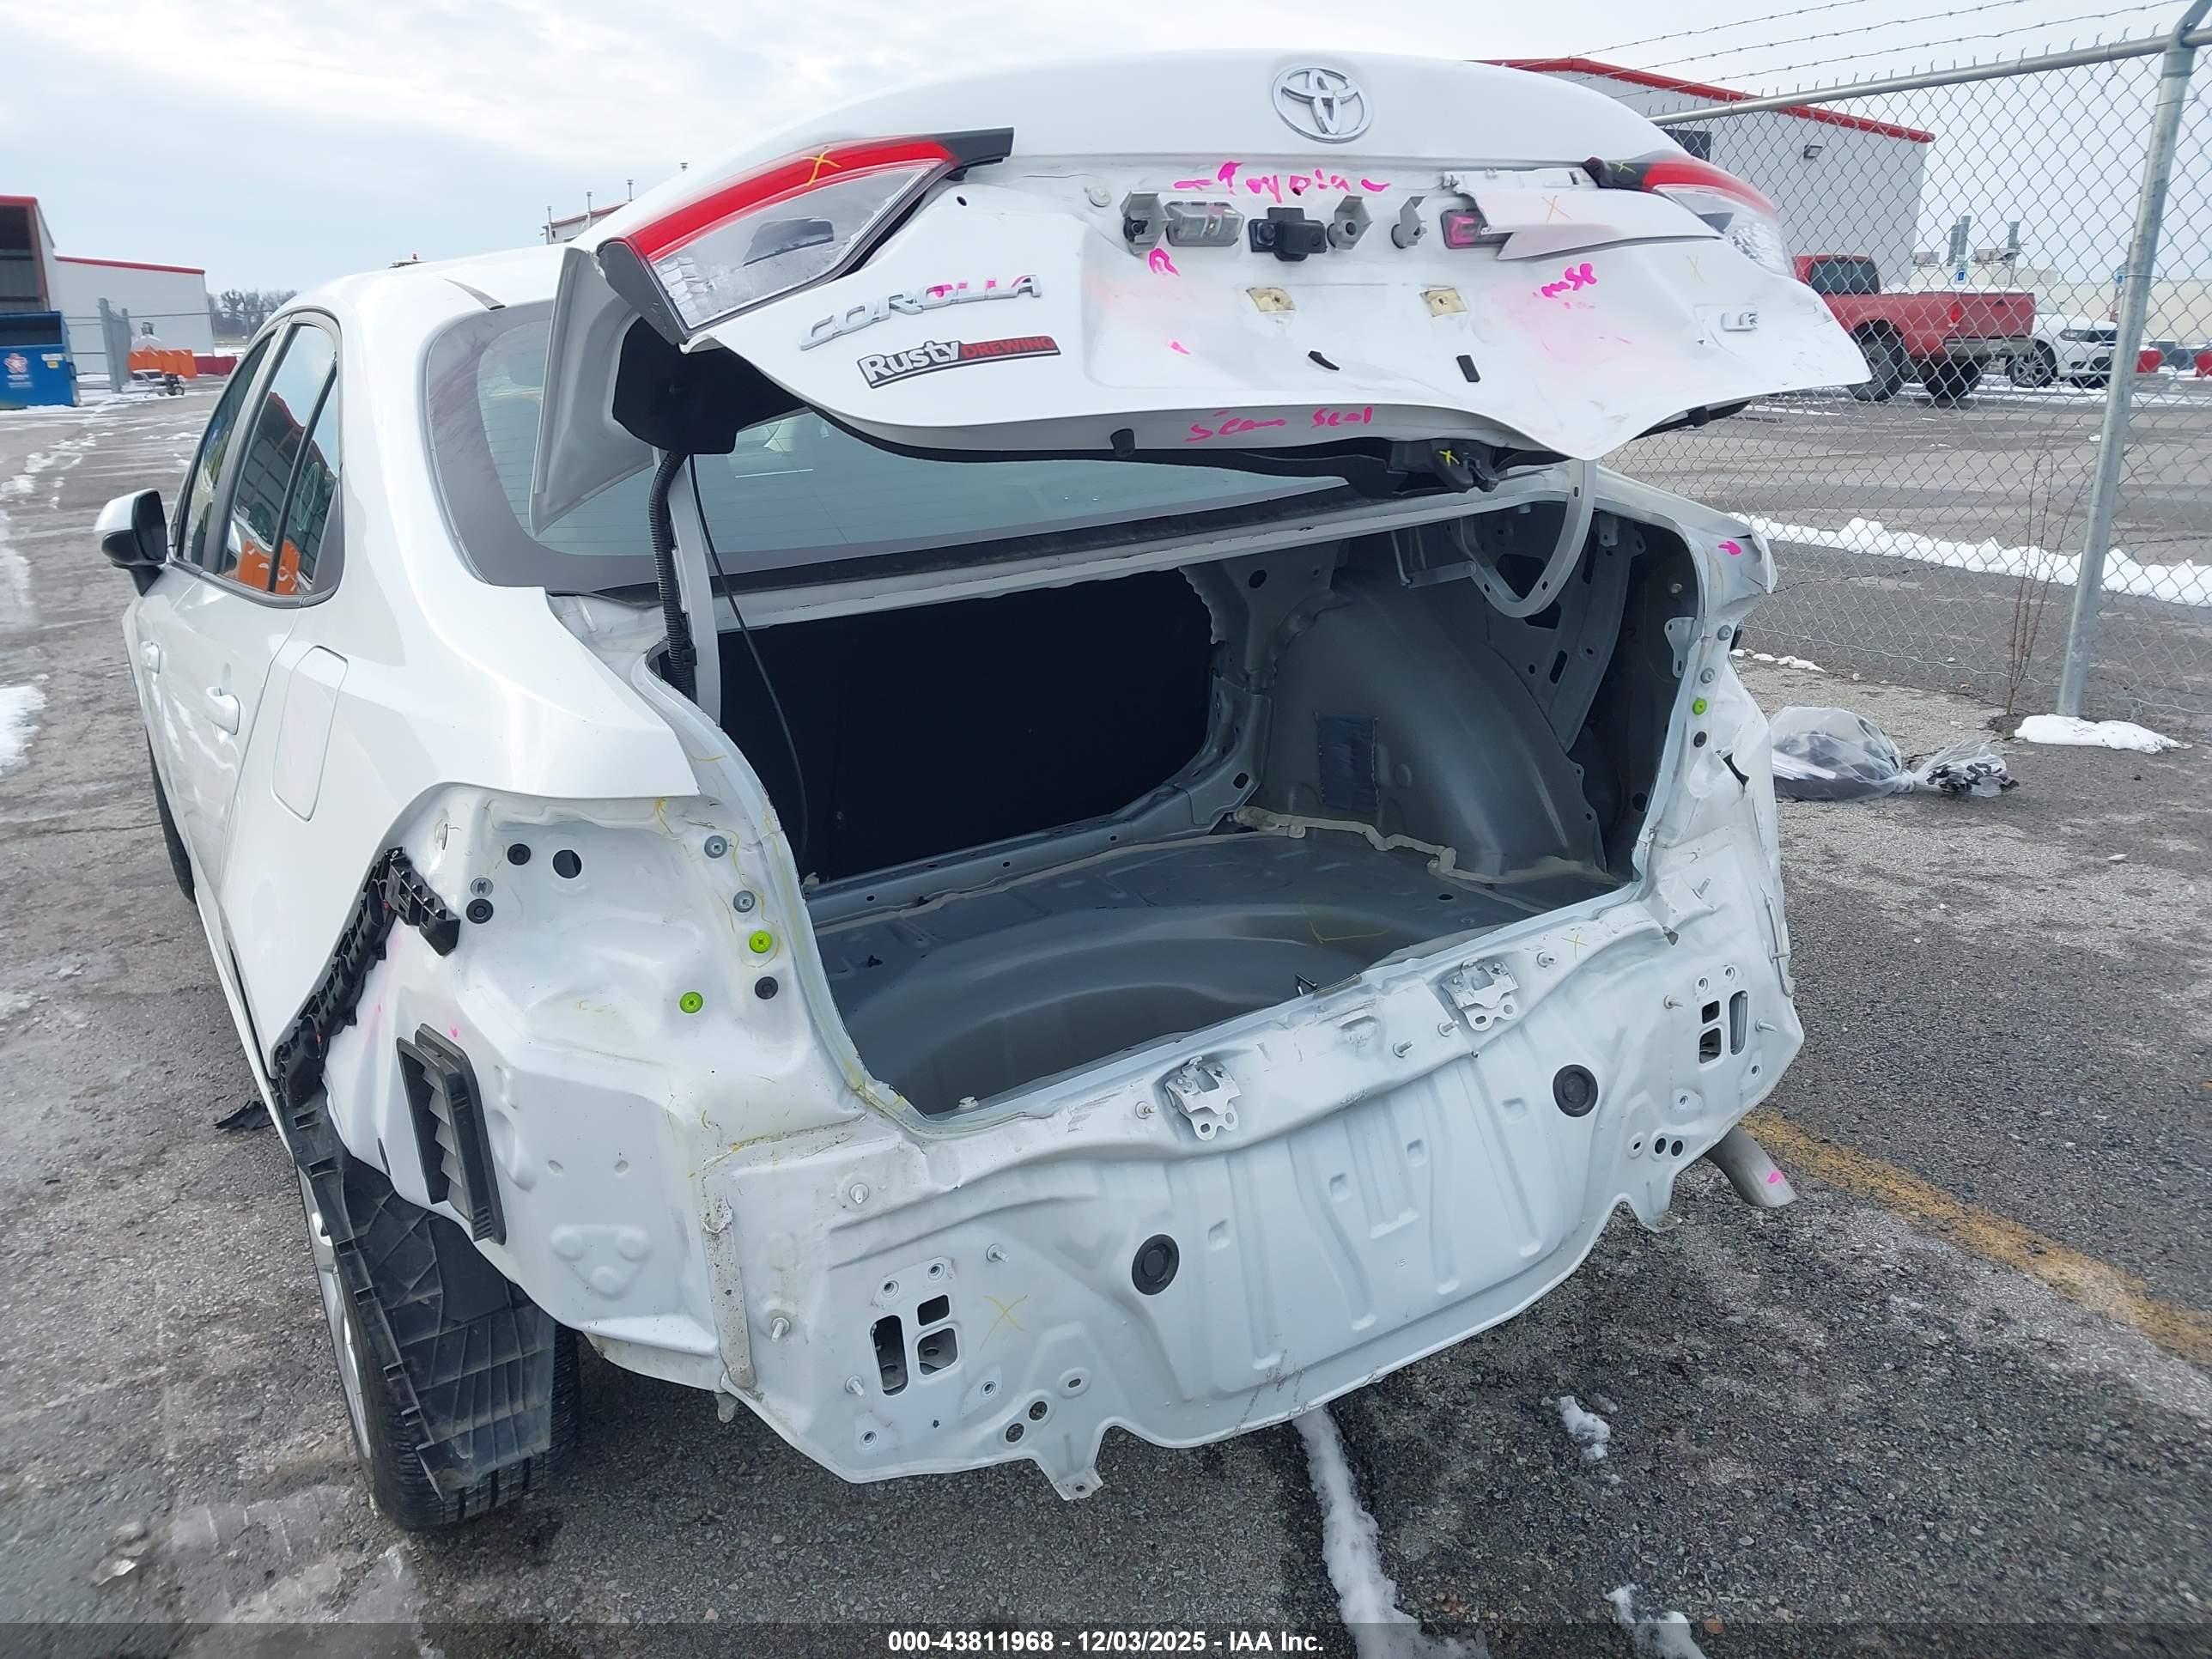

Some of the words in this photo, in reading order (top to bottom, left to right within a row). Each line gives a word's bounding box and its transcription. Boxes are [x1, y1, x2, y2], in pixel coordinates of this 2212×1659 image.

[798, 274, 1042, 350] COROLLA
[859, 341, 960, 383] Rusty
[961, 337, 1058, 359] DREWING
